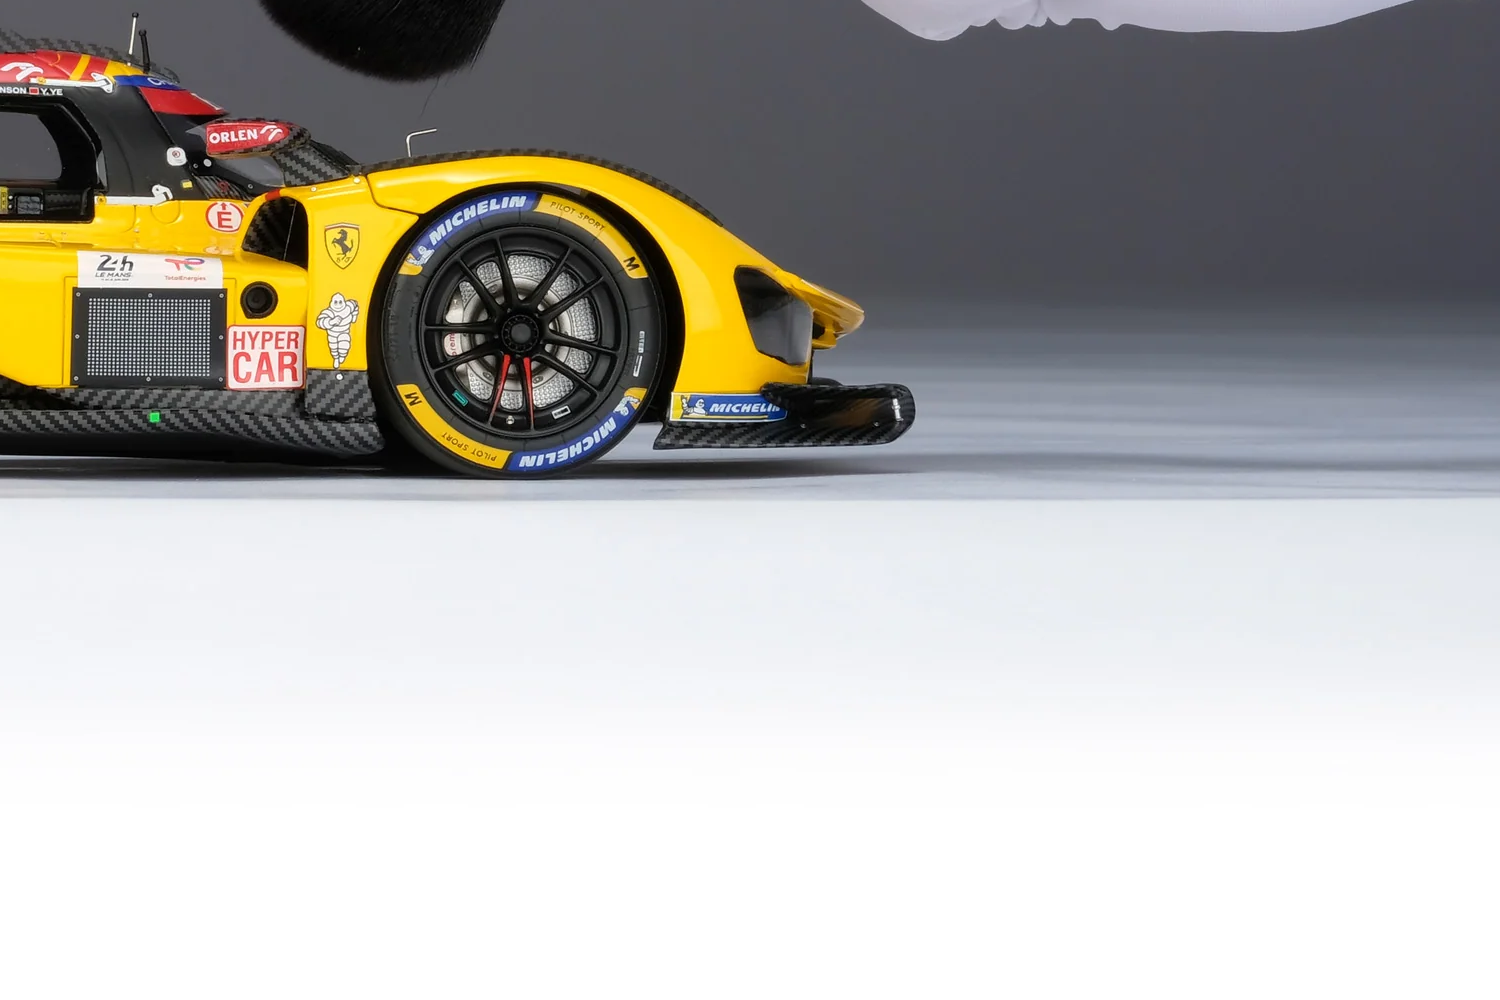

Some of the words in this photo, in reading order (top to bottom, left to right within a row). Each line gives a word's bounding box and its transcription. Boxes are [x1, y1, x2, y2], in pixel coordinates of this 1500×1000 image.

[209, 128, 259, 144] ORLEN
[216, 210, 234, 229] E
[428, 195, 527, 245] MICHELIN
[549, 201, 576, 215] PILOT
[577, 212, 607, 231] SPORT
[622, 256, 640, 272] M
[232, 330, 300, 350] HYPER
[232, 351, 299, 384] CAR
[403, 391, 423, 407] M
[709, 402, 781, 414] MICHELIN
[440, 431, 469, 451] SPORT
[518, 416, 618, 468] MICHELIN
[470, 448, 498, 462] PILOT
